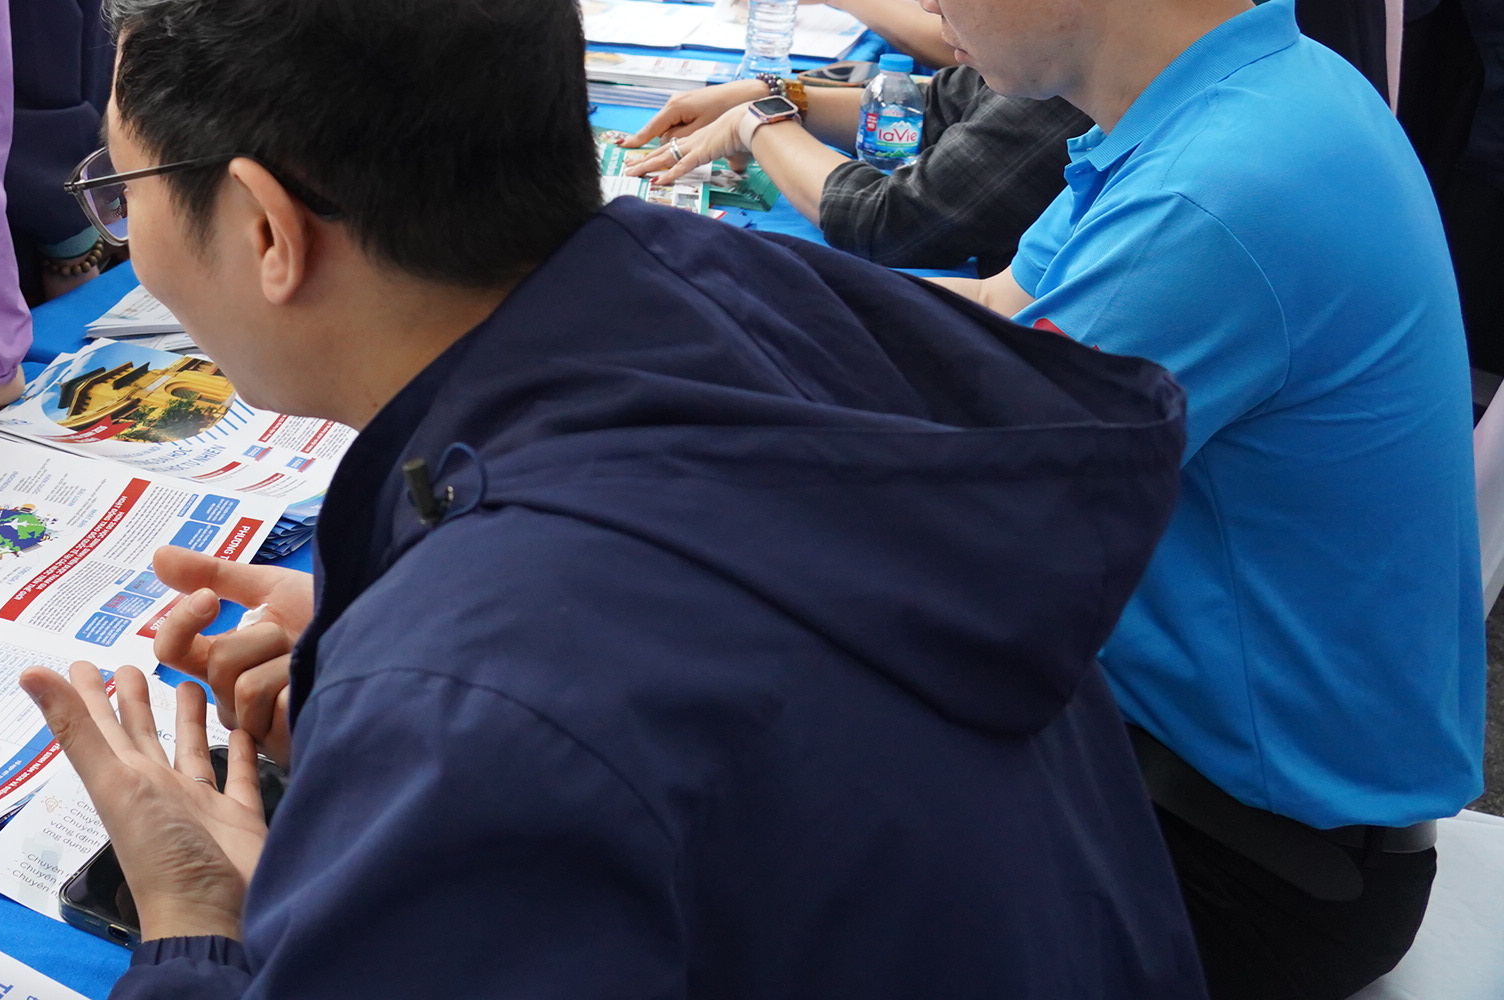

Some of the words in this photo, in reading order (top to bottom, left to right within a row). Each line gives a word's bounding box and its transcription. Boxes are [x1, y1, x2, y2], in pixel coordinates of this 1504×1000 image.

[878, 128, 918, 142] laVie
[49, 820, 74, 836] vững
[63, 815, 98, 835] Chuyên
[62, 837, 91, 854] dụng)
